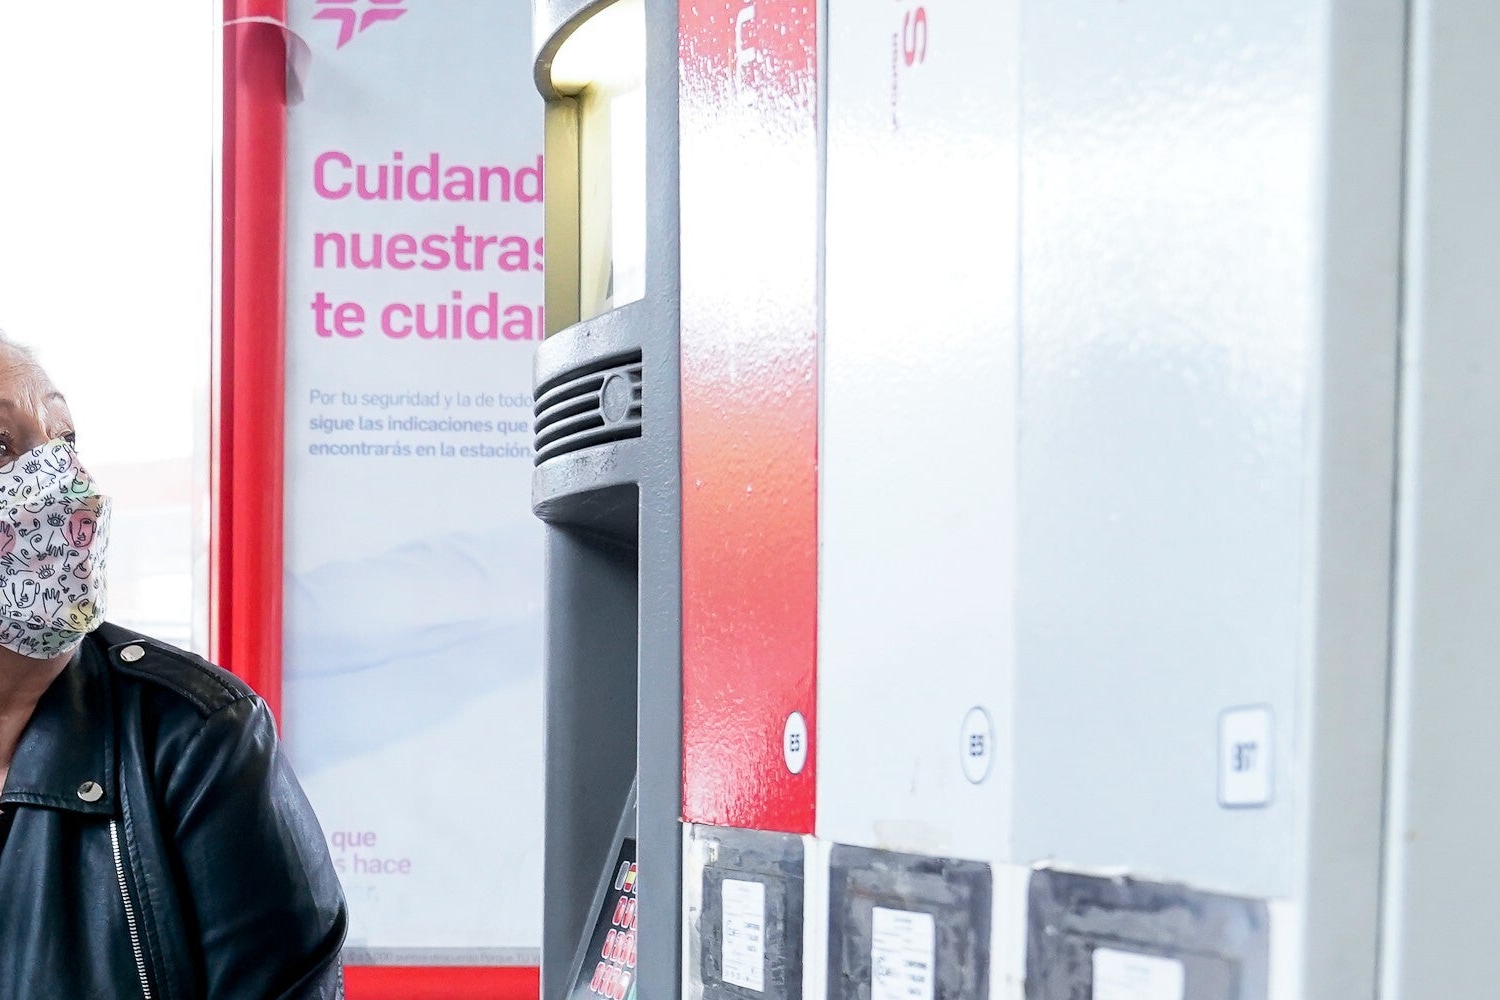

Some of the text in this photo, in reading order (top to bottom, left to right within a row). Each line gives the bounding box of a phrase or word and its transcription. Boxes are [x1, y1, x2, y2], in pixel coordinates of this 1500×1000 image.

[313, 151, 544, 203] Cuidand
[311, 290, 544, 341] te cuida
[309, 389, 336, 406] Por
[342, 391, 357, 406] tu
[362, 390, 440, 410] seguridad
[444, 395, 454, 410] y
[457, 391, 471, 407] la
[475, 392, 495, 407] de
[309, 416, 528, 435] sigue las indicaciones que
[309, 441, 411, 457] encontrarás
[416, 445, 436, 457] en
[441, 442, 455, 457] la
[331, 830, 377, 853] que
[353, 852, 411, 874] hace
